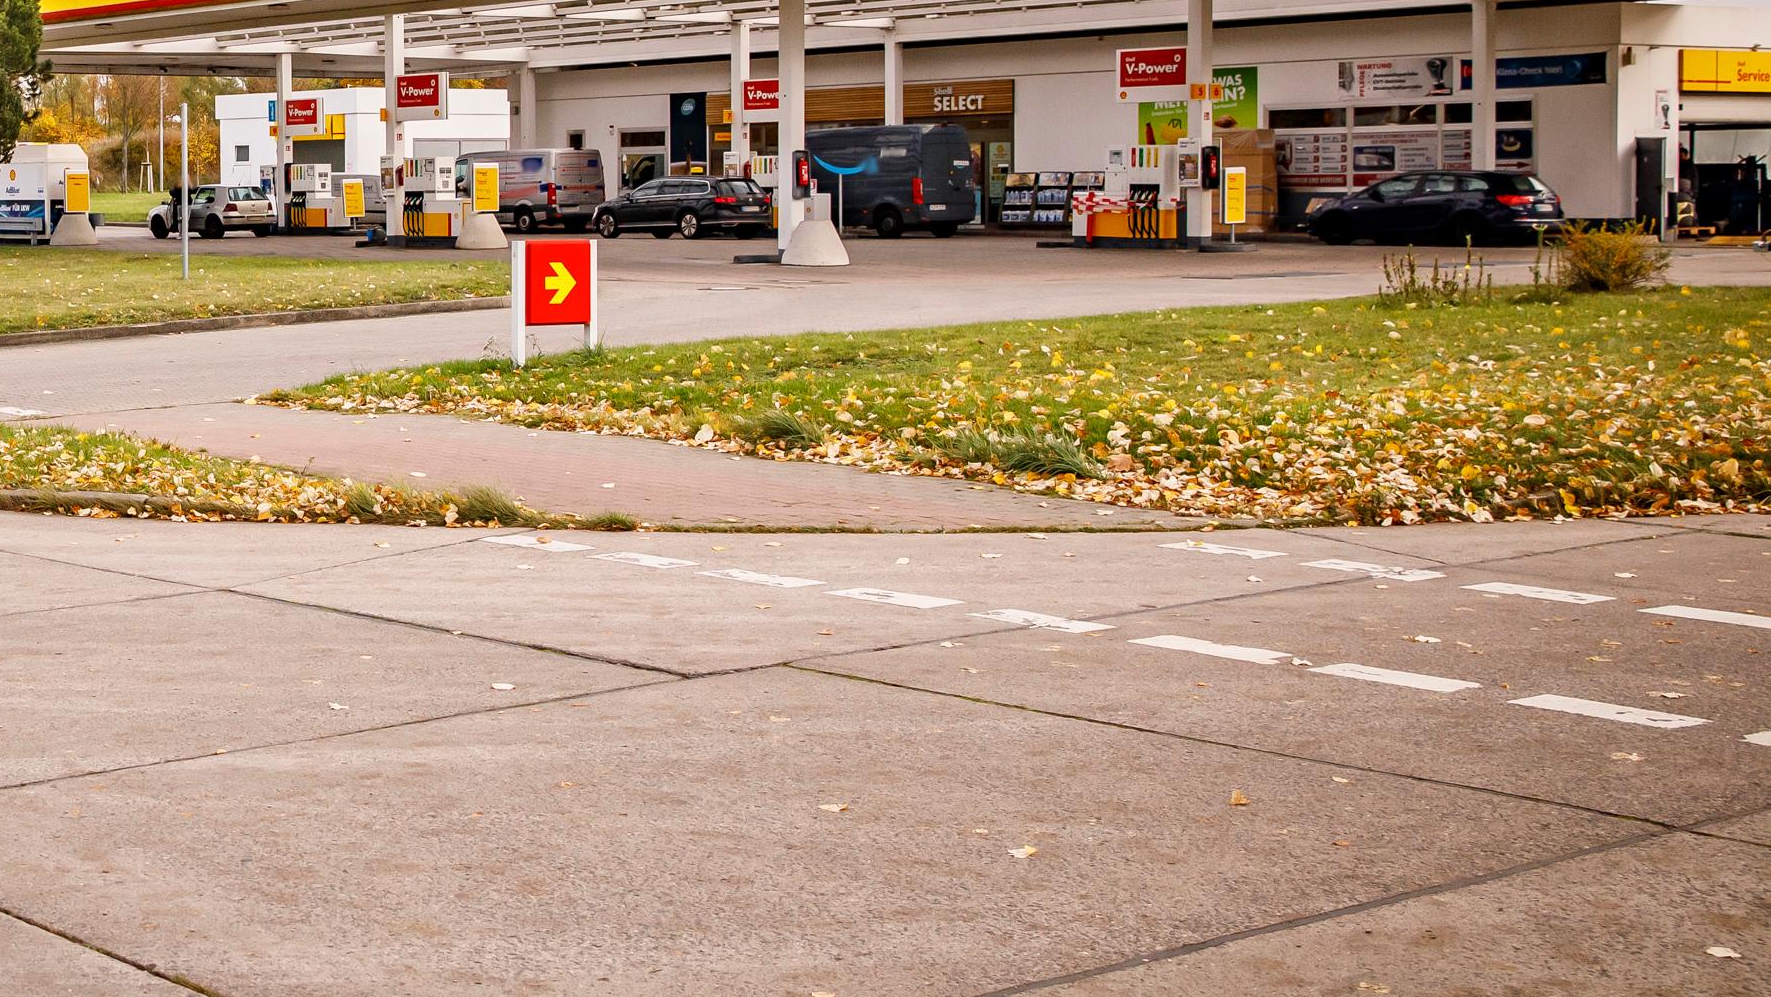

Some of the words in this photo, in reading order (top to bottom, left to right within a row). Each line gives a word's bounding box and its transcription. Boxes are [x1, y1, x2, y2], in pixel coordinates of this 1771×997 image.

[1126, 62, 1178, 74] V-Power
[1357, 63, 1392, 71] WARTUNG
[1737, 69, 1770, 82] Service
[400, 86, 434, 97] V-Power
[748, 91, 779, 100] V-Powe
[933, 95, 985, 112] SELECT
[288, 108, 314, 117] V-Power
